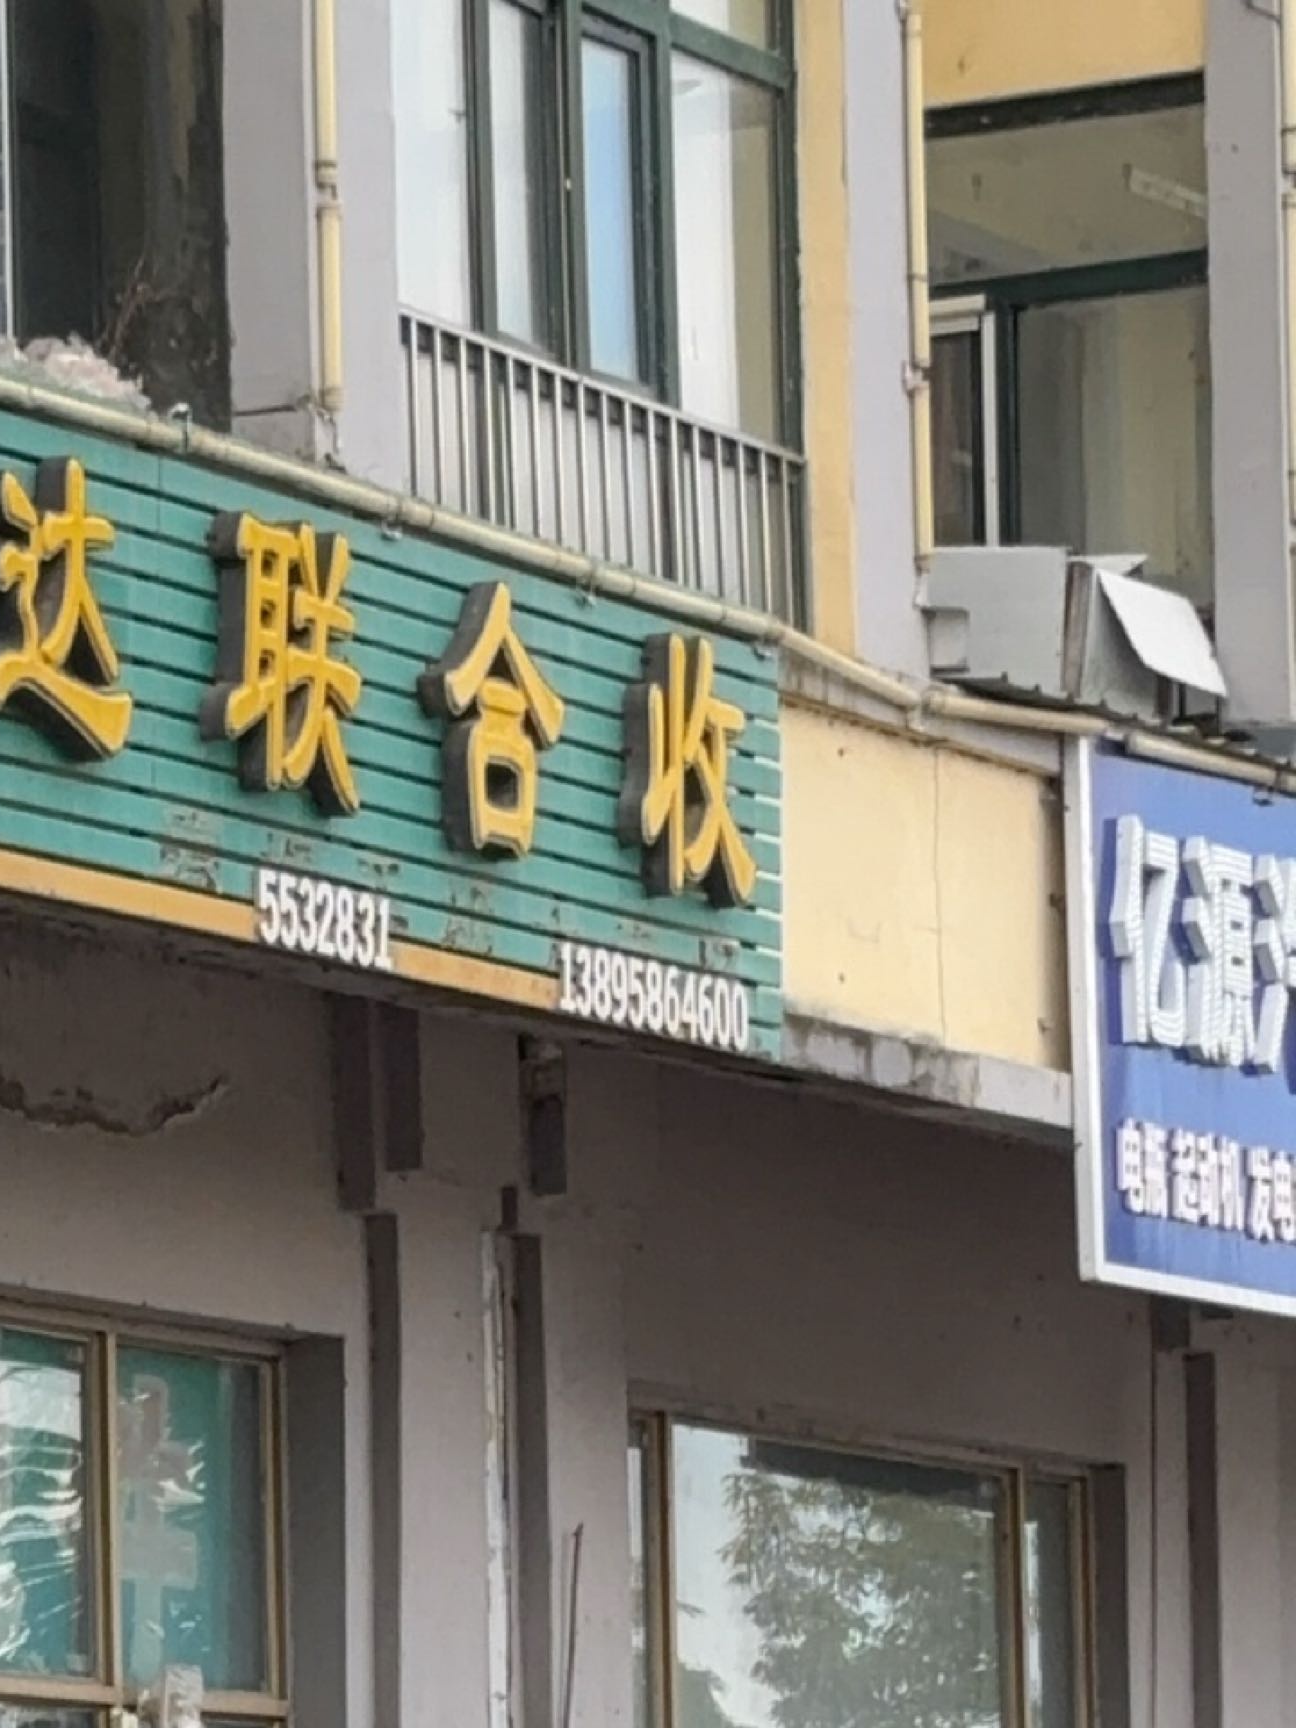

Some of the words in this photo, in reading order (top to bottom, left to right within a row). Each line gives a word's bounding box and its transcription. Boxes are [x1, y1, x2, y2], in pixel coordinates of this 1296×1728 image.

[257, 868, 394, 972] 5532831
[556, 940, 750, 1053] 13895864600
[1116, 1118, 1168, 1217] 电瓶
